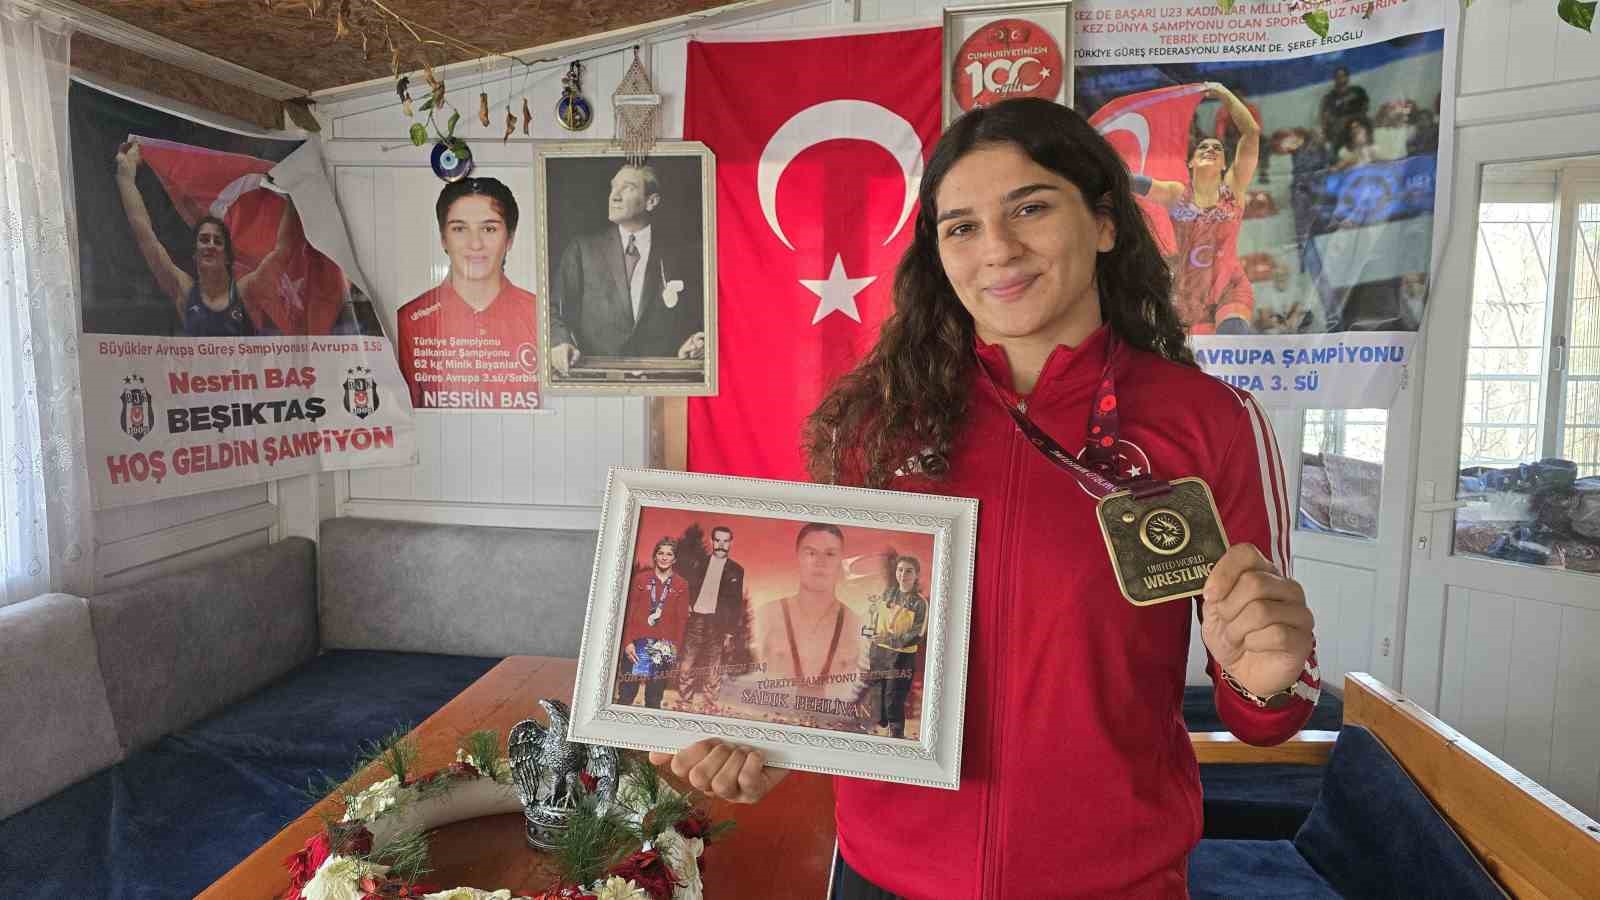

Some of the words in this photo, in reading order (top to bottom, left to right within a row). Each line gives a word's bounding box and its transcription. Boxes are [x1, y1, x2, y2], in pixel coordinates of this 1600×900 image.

[1096, 10, 1112, 20] DE
[1160, 8, 1183, 18] U23
[1082, 22, 1104, 33] KEZ
[1107, 20, 1148, 33] DÜNYA
[1152, 16, 1225, 33] ŞAMPİYONU
[1228, 17, 1262, 29] OLAN
[1160, 31, 1199, 45] TEBRİK
[1115, 45, 1145, 58] GÜREŞ
[1149, 46, 1219, 56] FEDERASYONU
[1223, 43, 1266, 54] BAŞKANI
[1288, 38, 1320, 52] ŞEREF
[99, 341, 153, 357] Büyükler
[156, 343, 194, 357] Avrupa
[198, 343, 234, 356] Güreş
[311, 341, 359, 354] Avrupa
[413, 336, 448, 348] Türkiye
[450, 336, 501, 348] Şampiyonu
[414, 348, 457, 358] Balkanlar
[459, 348, 511, 361] Şampiyonu
[1196, 347, 1275, 366] AVRUPA
[1282, 342, 1404, 368] ŞAMPİYONU
[414, 360, 427, 369] 62
[430, 359, 443, 371] kg
[446, 360, 472, 369] Minik
[475, 360, 520, 371] Bayanlar
[168, 368, 257, 395] Nesrin
[264, 366, 317, 390] BAŞ
[446, 373, 480, 384] Avrupa
[1270, 375, 1288, 391] 3.
[1294, 370, 1319, 391] SÜ
[106, 450, 168, 484] HOŞ
